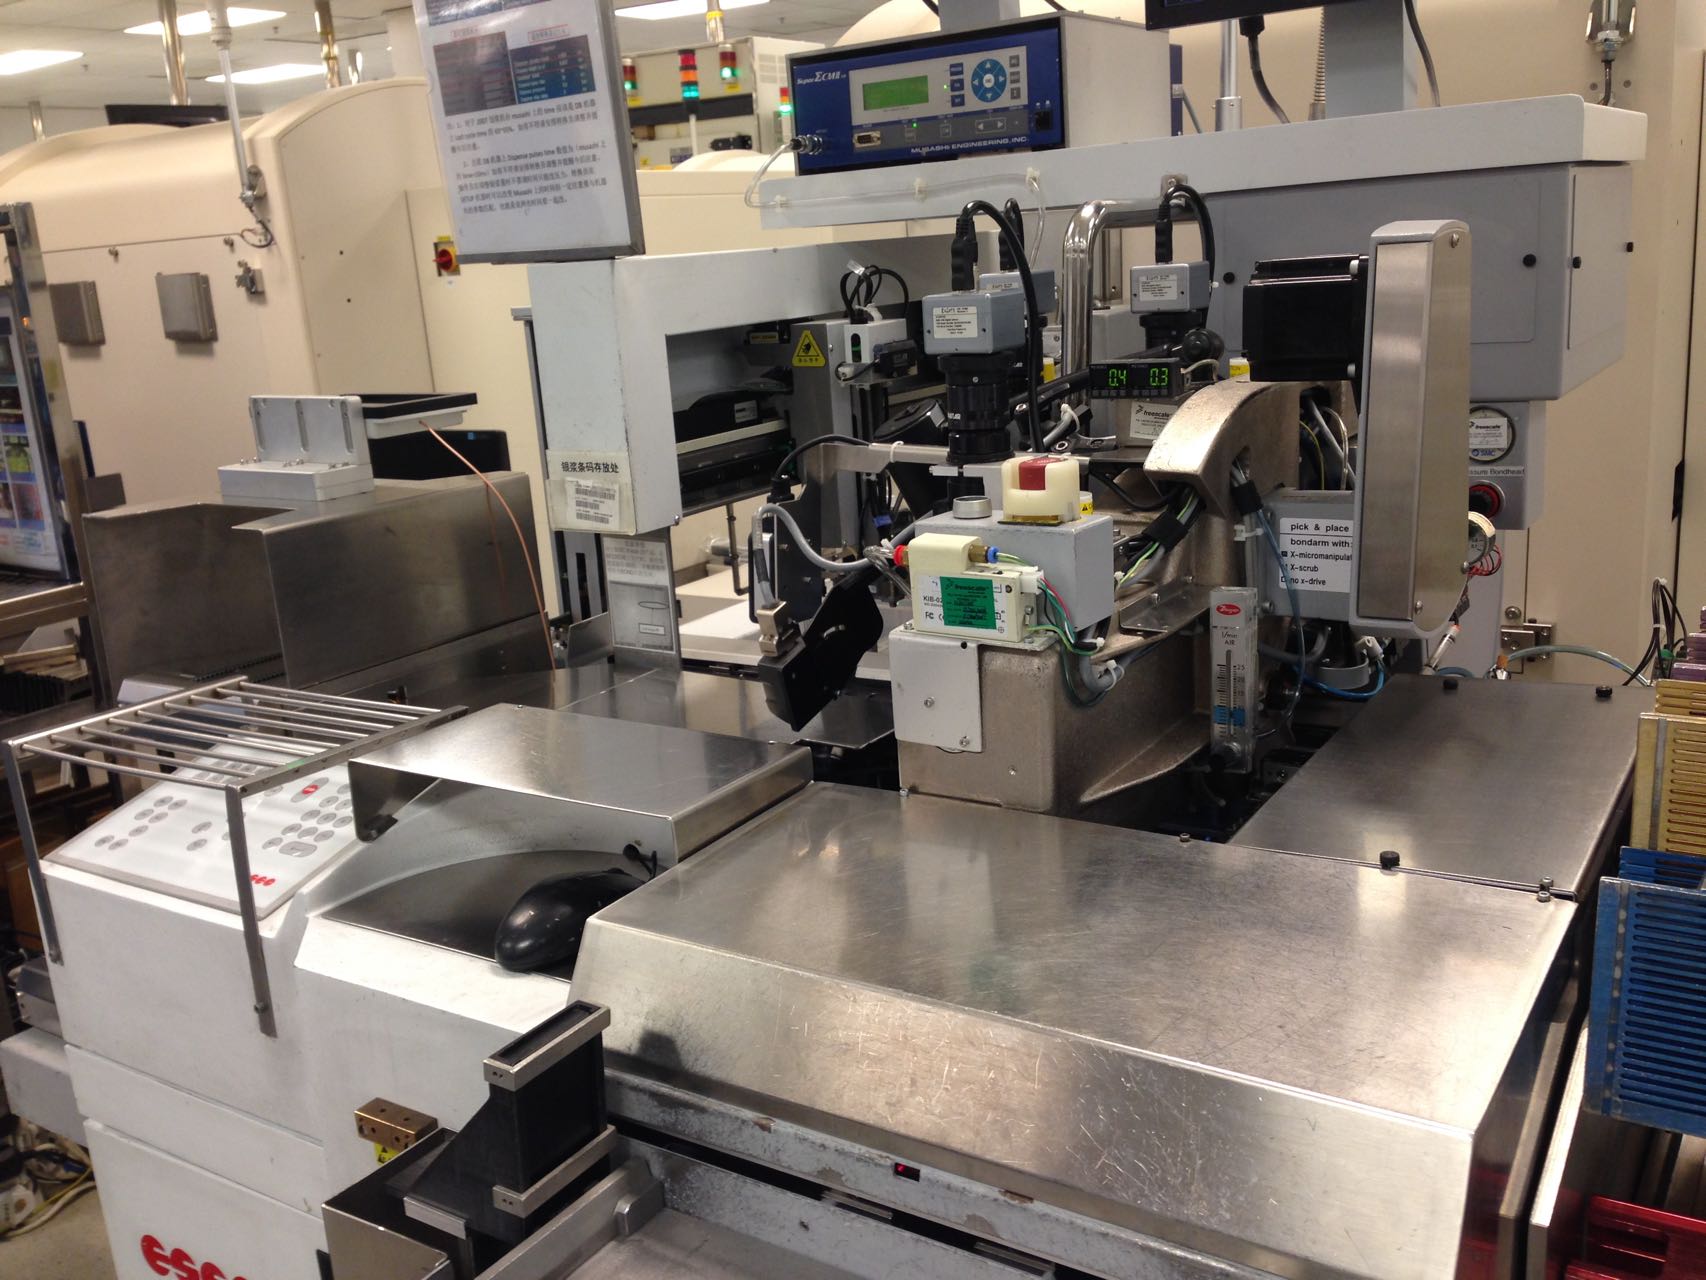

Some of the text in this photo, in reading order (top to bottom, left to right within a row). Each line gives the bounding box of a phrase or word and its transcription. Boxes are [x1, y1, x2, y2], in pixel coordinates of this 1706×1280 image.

[1290, 522, 1350, 533] pick & place
[1290, 538, 1330, 547] bondarm
[1290, 563, 1319, 572] X-scrub
[1300, 577, 1327, 586] x-drive
